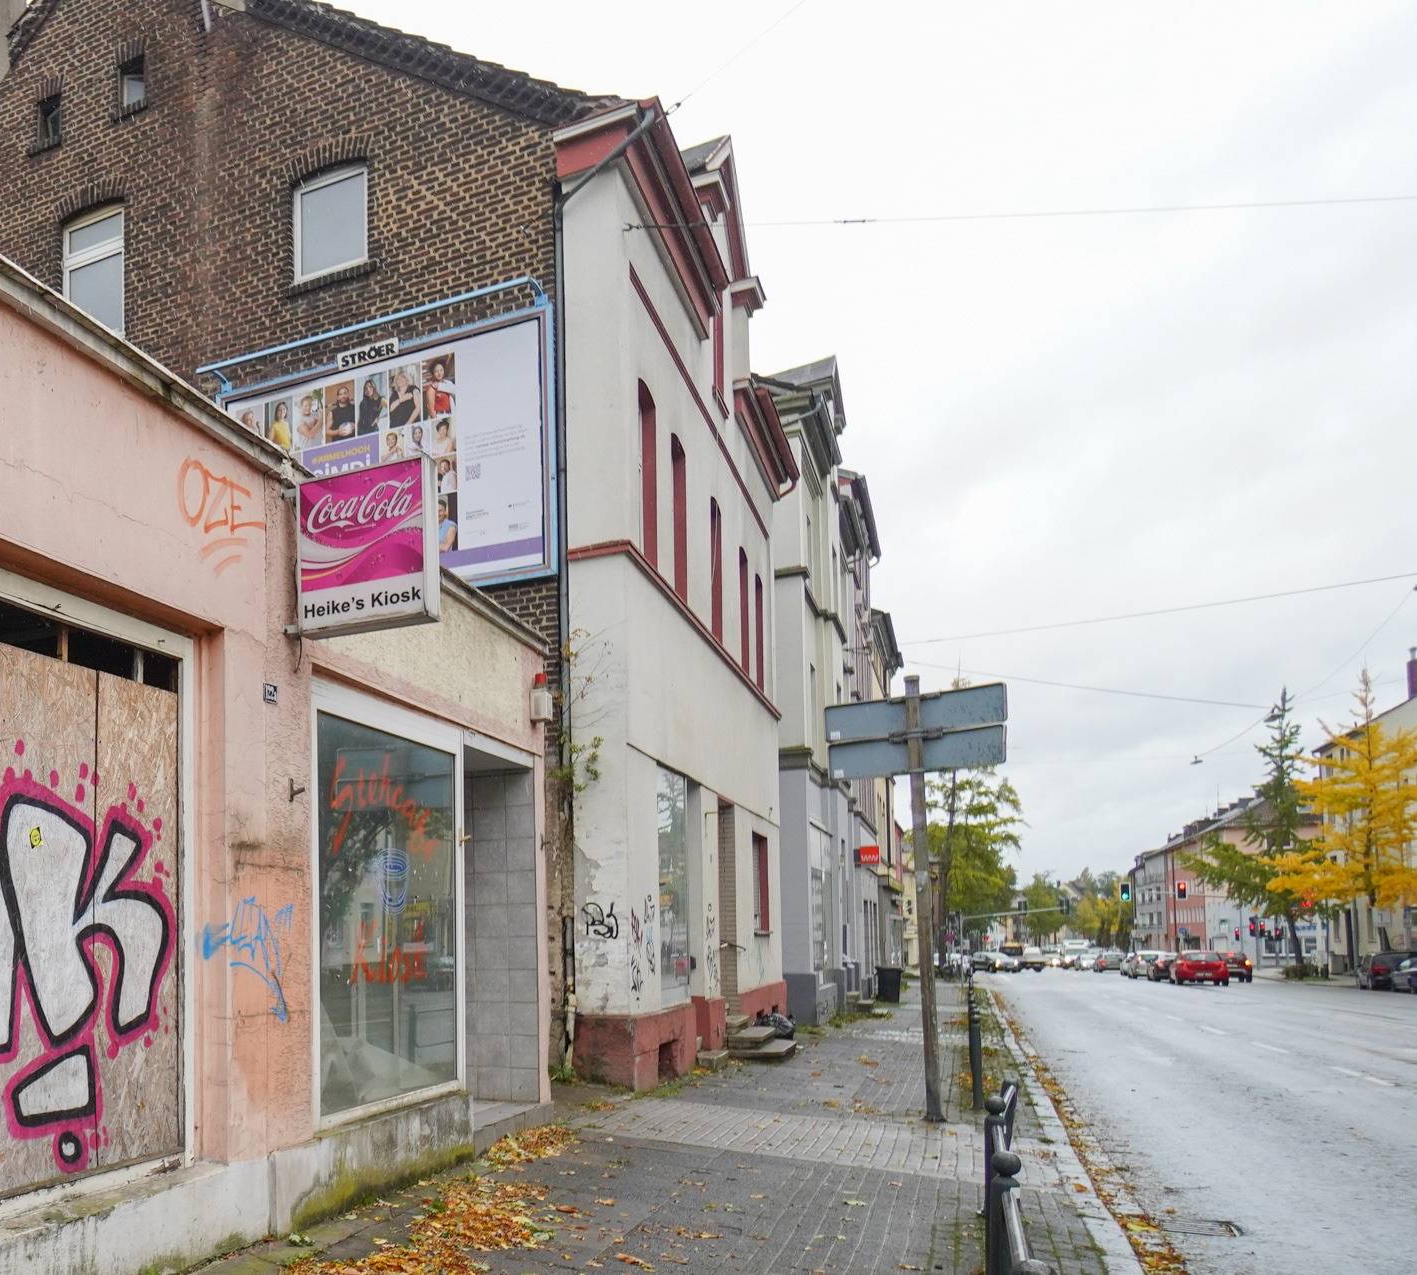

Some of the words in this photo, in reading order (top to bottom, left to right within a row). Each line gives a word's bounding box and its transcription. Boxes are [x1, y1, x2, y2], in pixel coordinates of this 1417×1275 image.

[341, 343, 395, 367] STRÖER
[306, 477, 418, 534] Coca-Cola
[304, 597, 365, 619] Heike's
[371, 586, 422, 608] Kiosk
